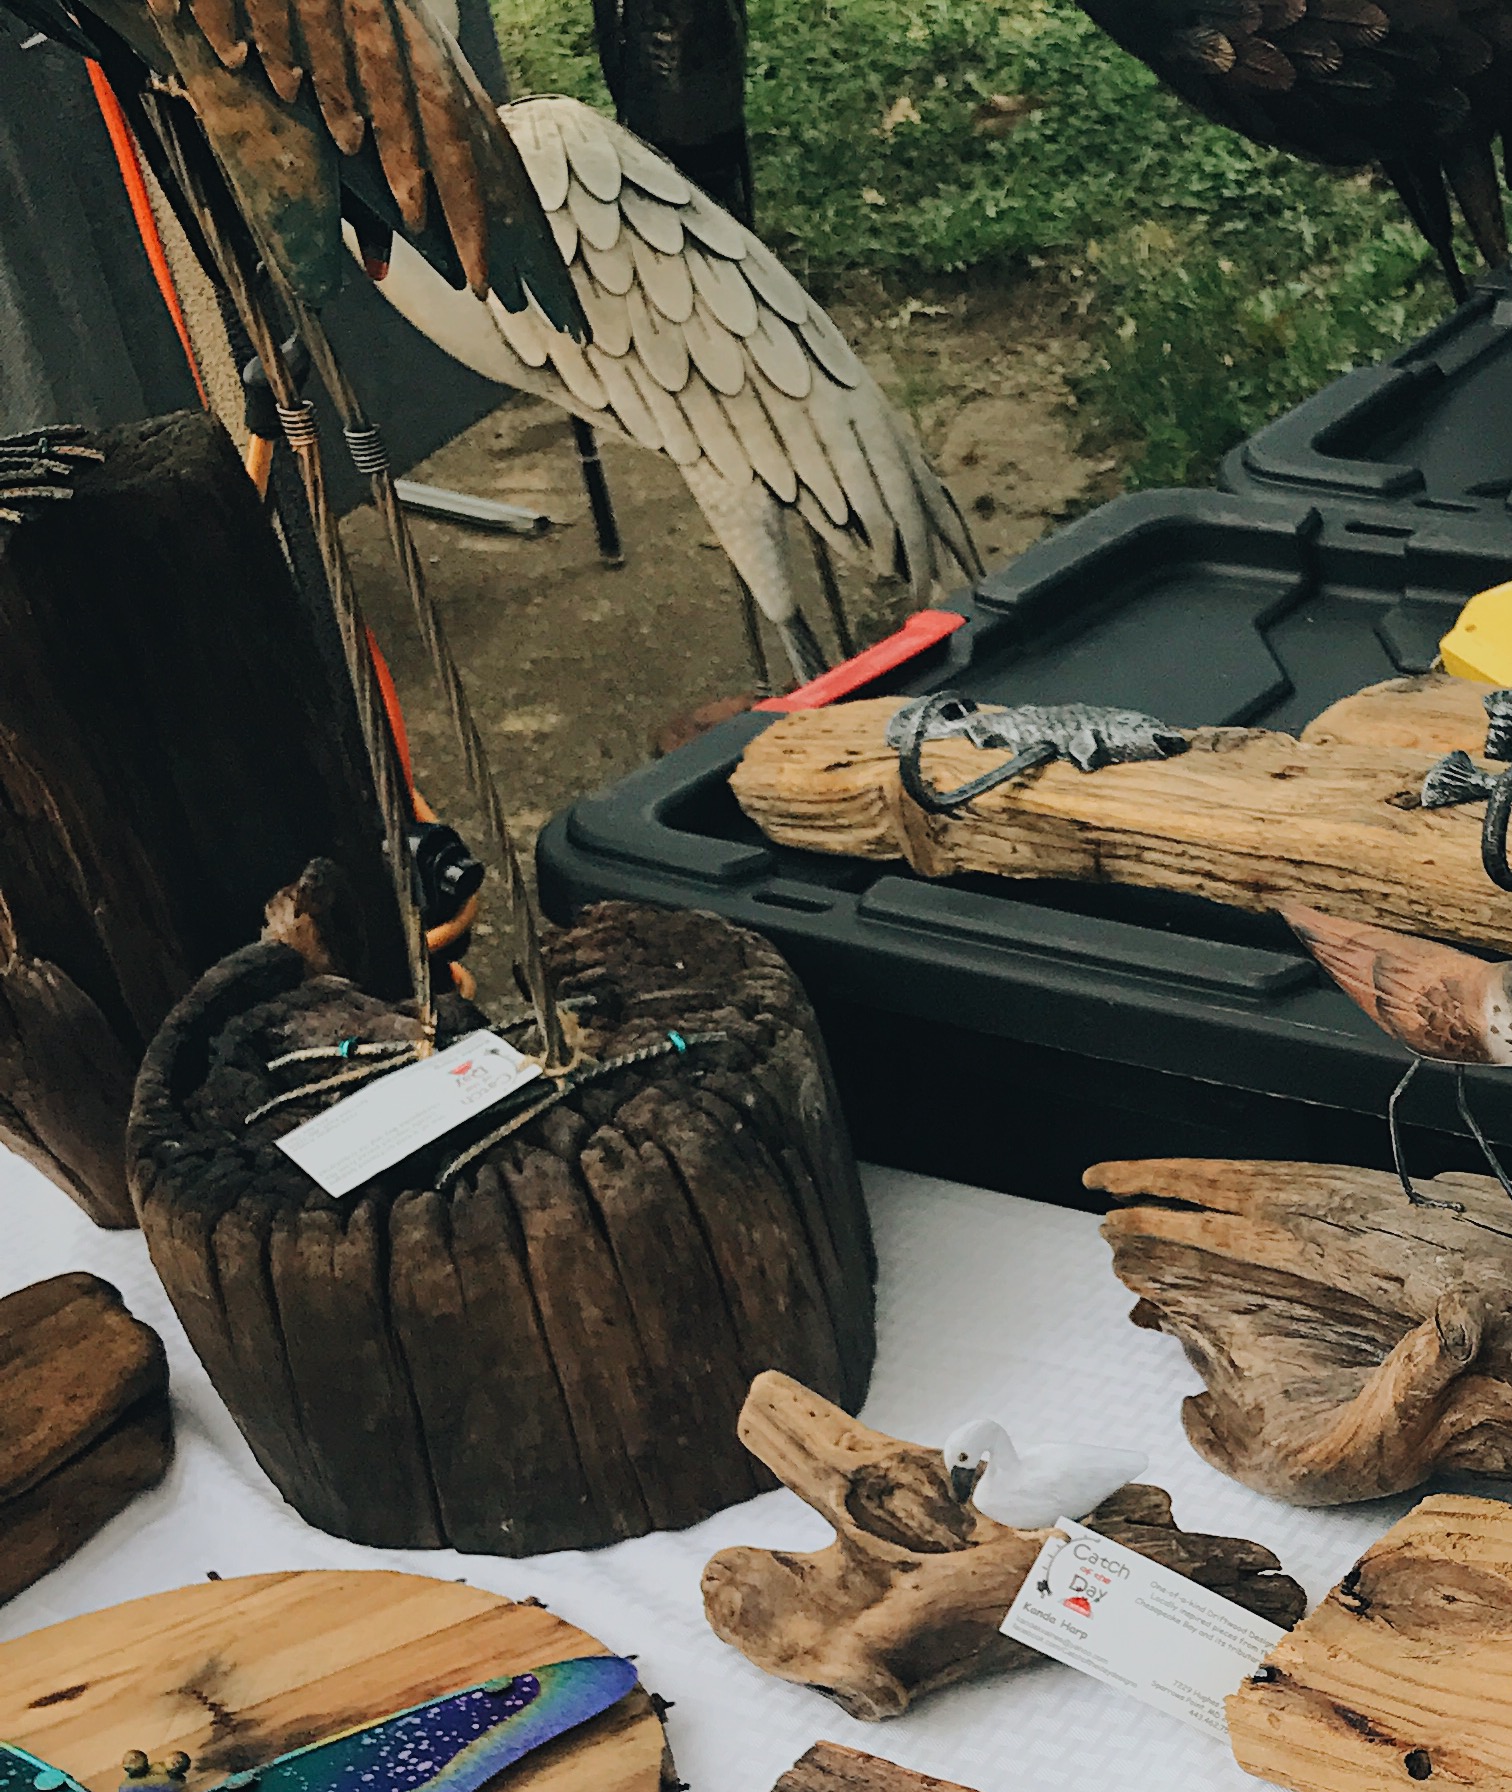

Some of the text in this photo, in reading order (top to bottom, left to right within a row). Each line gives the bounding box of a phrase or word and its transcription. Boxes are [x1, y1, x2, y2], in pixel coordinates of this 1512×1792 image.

[1073, 1543, 1130, 1580] Catch
[1069, 1574, 1107, 1603] Day
[1023, 1602, 1056, 1624] Kanda
[1060, 1620, 1088, 1639] Harp
[1199, 1631, 1214, 1640] and
[1239, 1638, 1258, 1652] from
